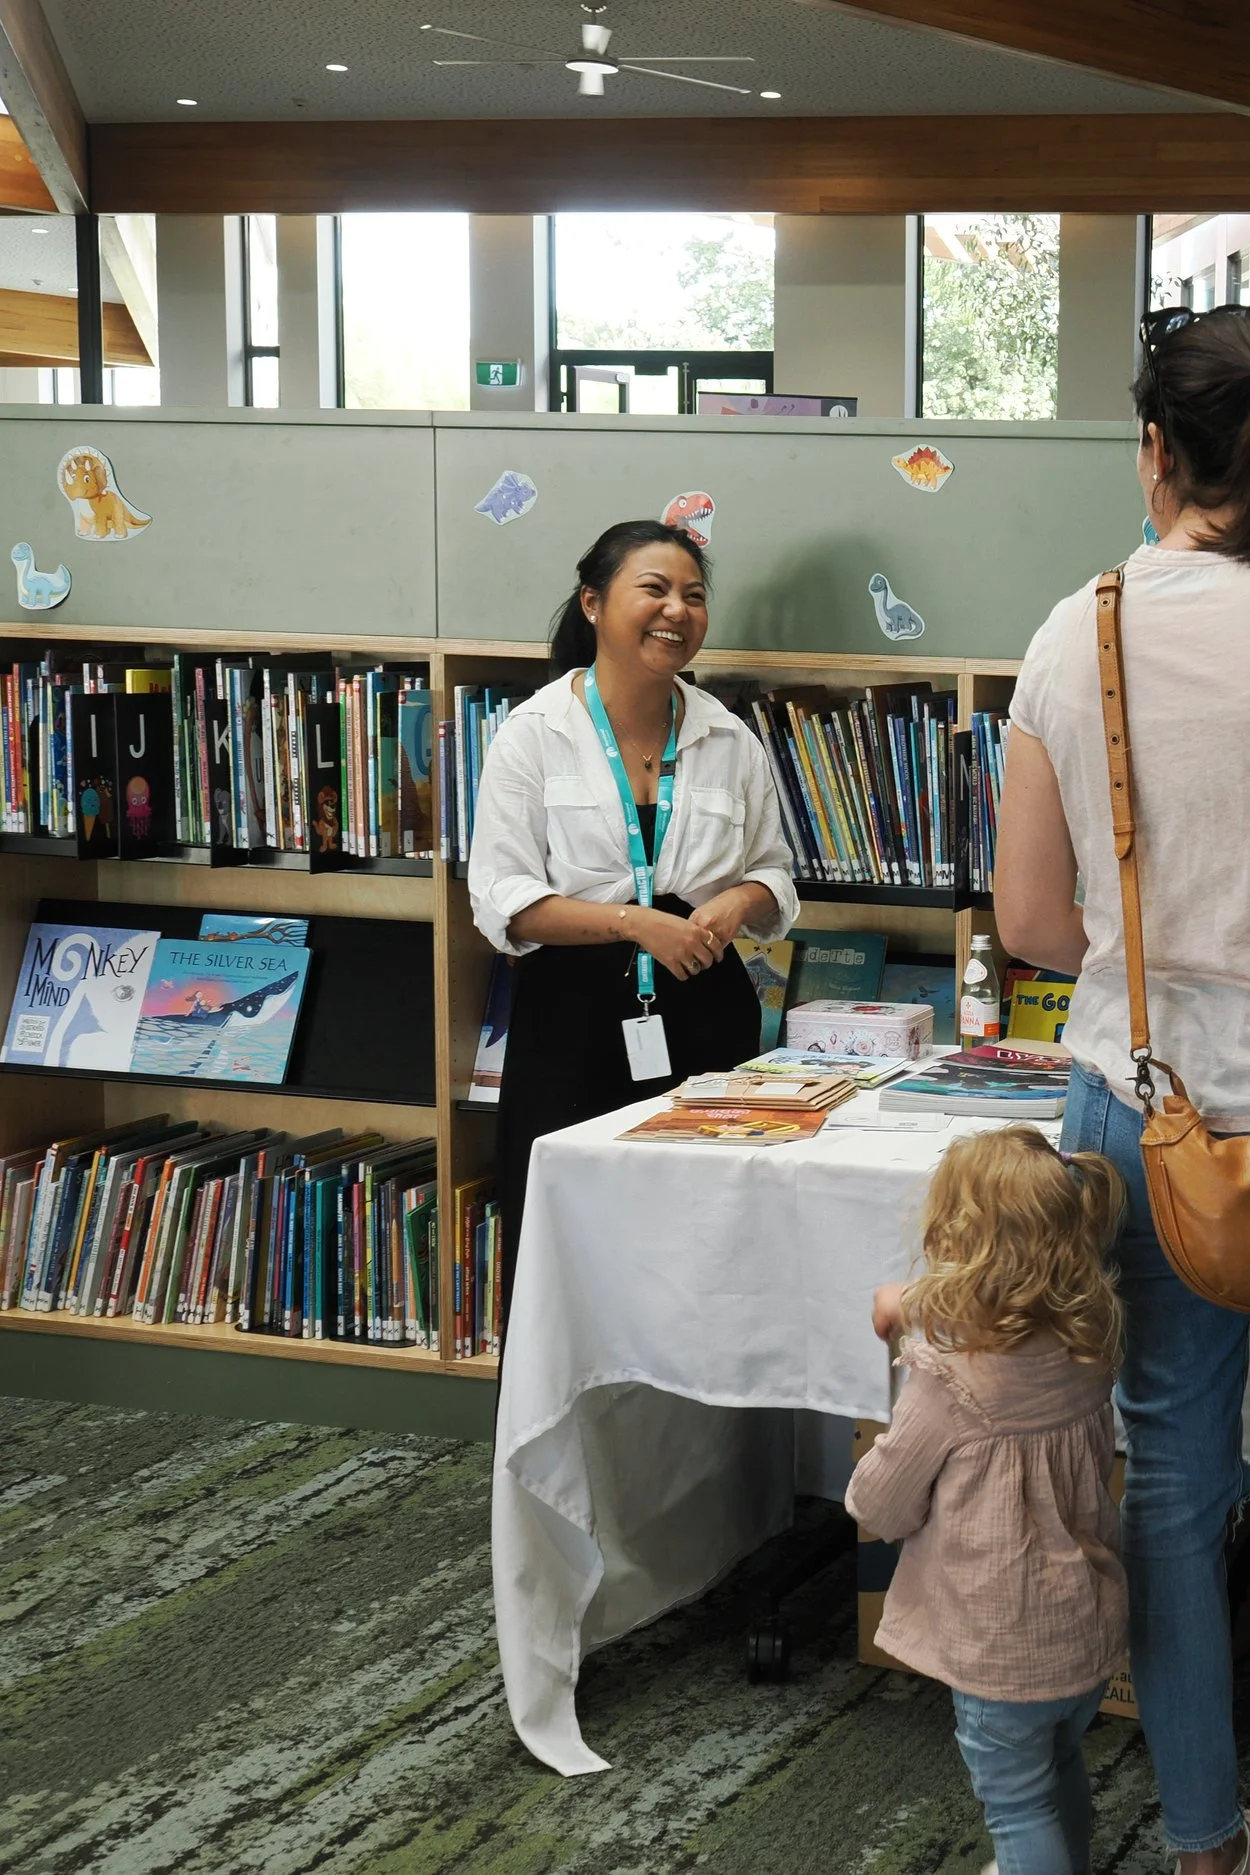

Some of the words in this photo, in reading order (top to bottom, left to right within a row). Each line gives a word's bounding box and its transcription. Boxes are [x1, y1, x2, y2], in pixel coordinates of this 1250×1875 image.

[90, 714, 98, 758] I
[129, 714, 146, 759] J
[212, 719, 230, 764] K
[315, 724, 335, 769] L
[170, 951, 201, 966] THE
[204, 953, 255, 970] SILVER
[258, 957, 288, 971] SEA
[961, 1016, 980, 1026] ANNA
[1016, 994, 1039, 1005] THE
